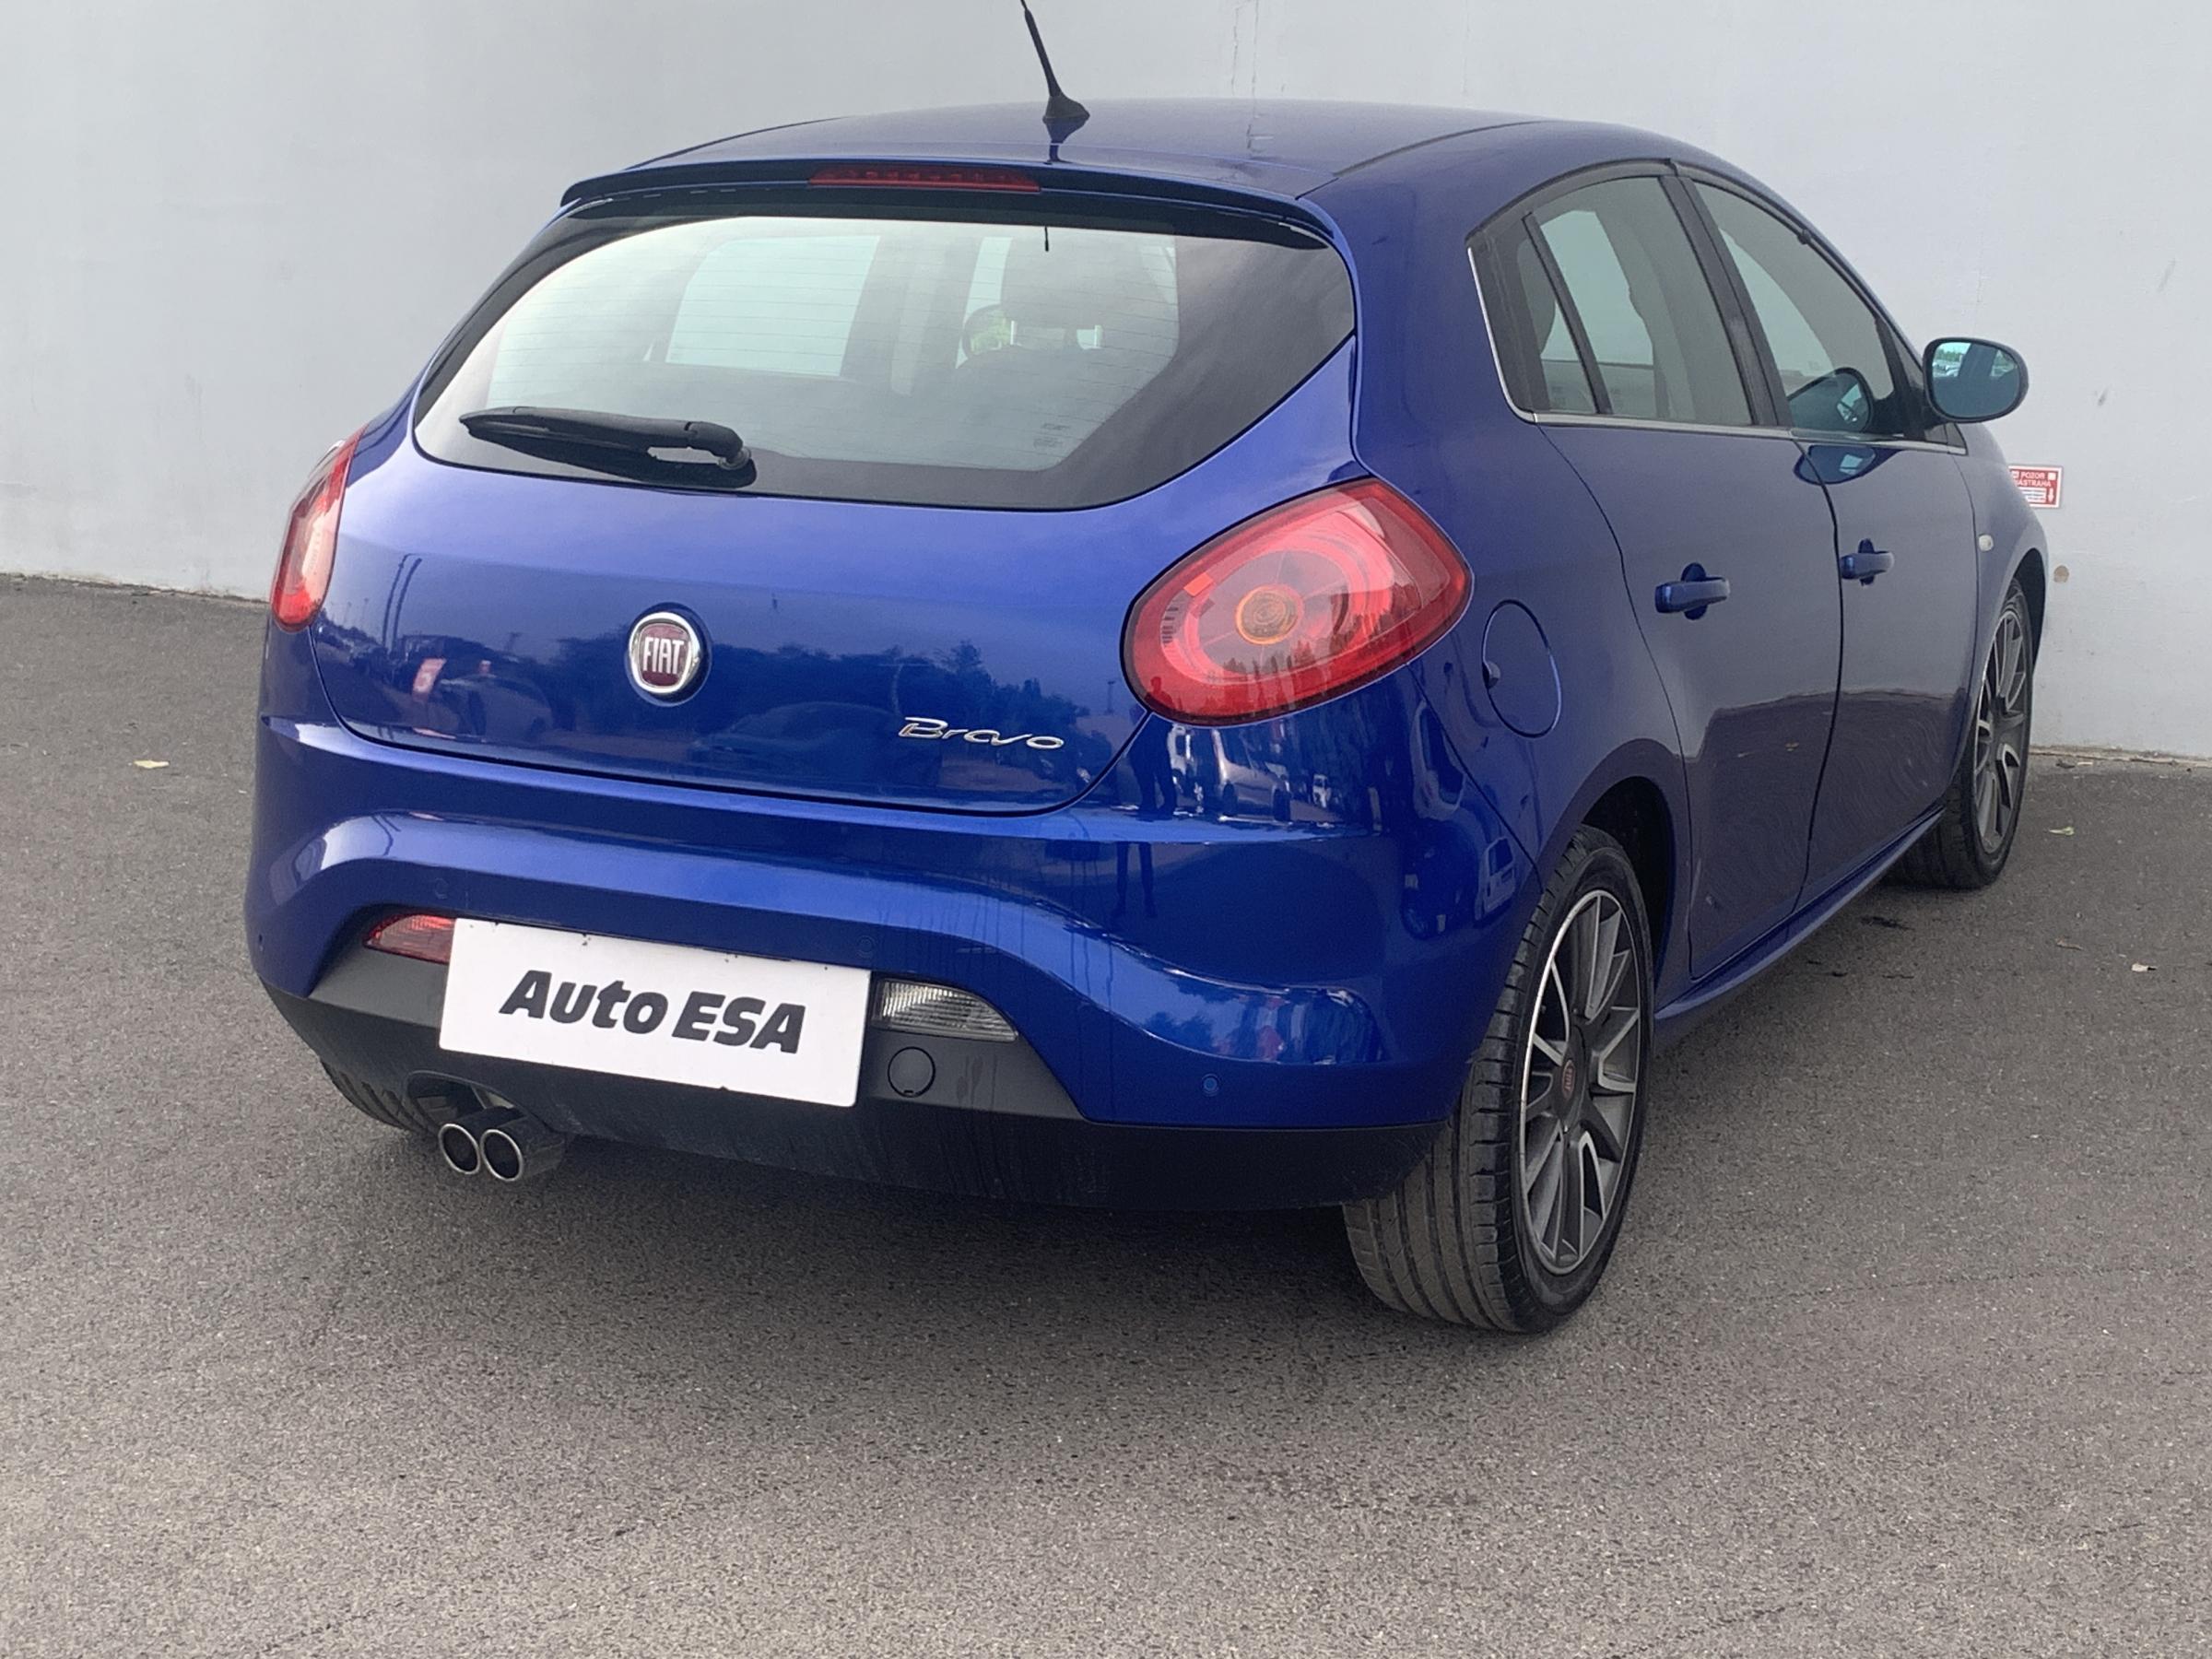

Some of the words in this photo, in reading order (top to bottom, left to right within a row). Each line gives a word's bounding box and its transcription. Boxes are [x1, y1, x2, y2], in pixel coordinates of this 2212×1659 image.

[643, 636, 685, 675] FIAT
[898, 717, 1065, 749] Bravo
[499, 970, 669, 1035] Auto
[671, 991, 807, 1055] ESA
